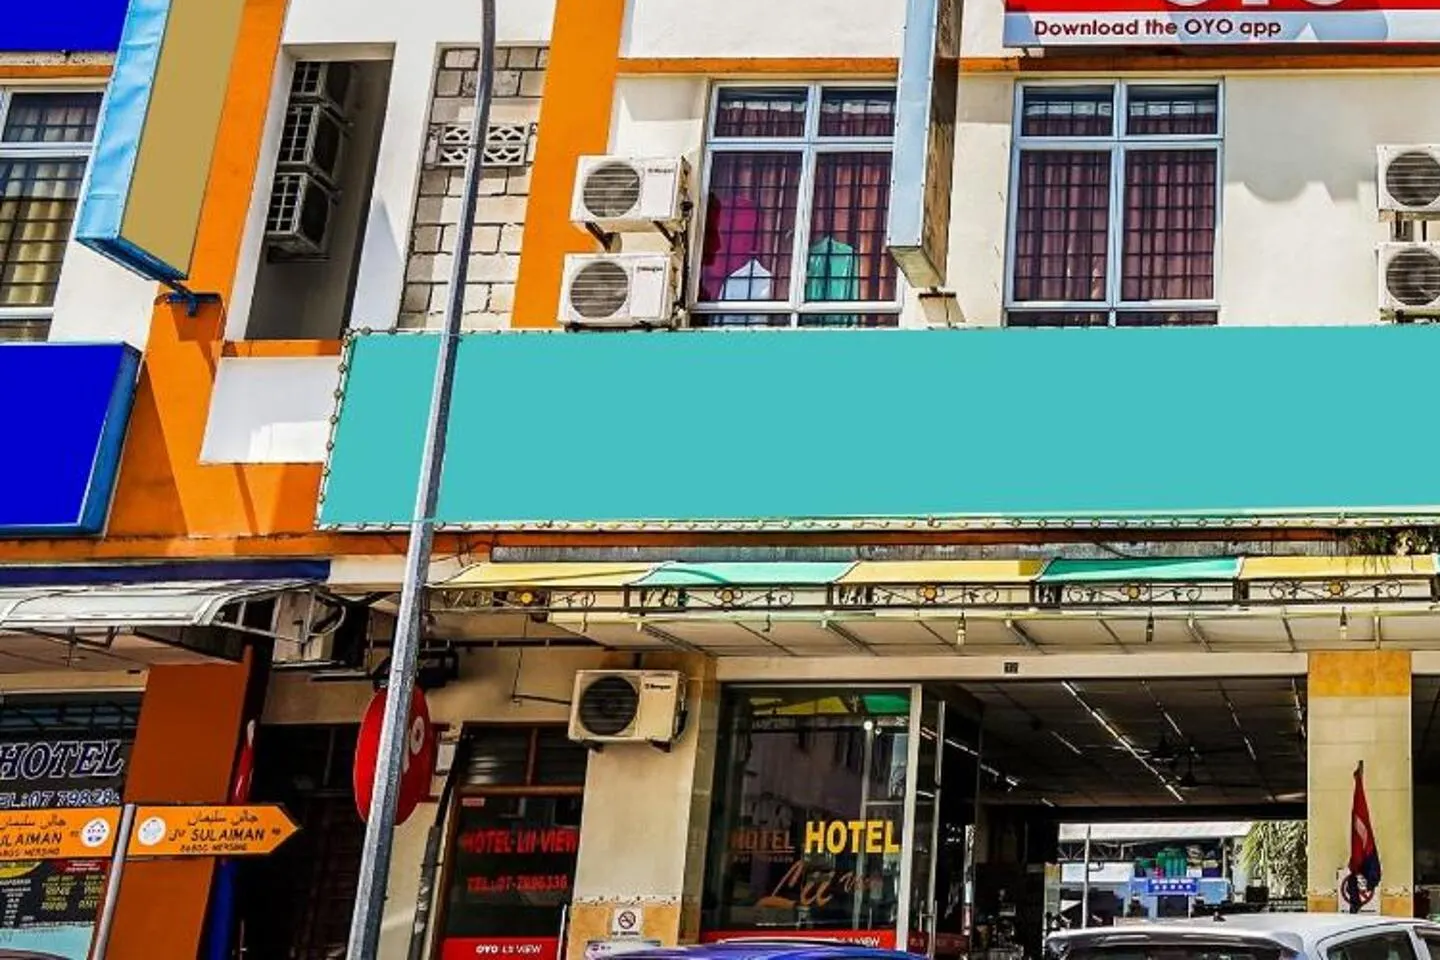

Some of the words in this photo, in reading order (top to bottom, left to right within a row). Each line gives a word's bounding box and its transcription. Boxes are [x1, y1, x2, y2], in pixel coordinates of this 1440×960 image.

[1034, 19, 1138, 36] Download
[1145, 19, 1178, 35] the
[1184, 18, 1233, 35] OYO
[1240, 21, 1282, 37] app
[0, 740, 125, 780] HOTEL
[191, 827, 266, 841] SULAIMAN
[463, 829, 512, 853] HOTEL
[804, 820, 900, 854] HOTEL
[475, 944, 499, 954] OYO
